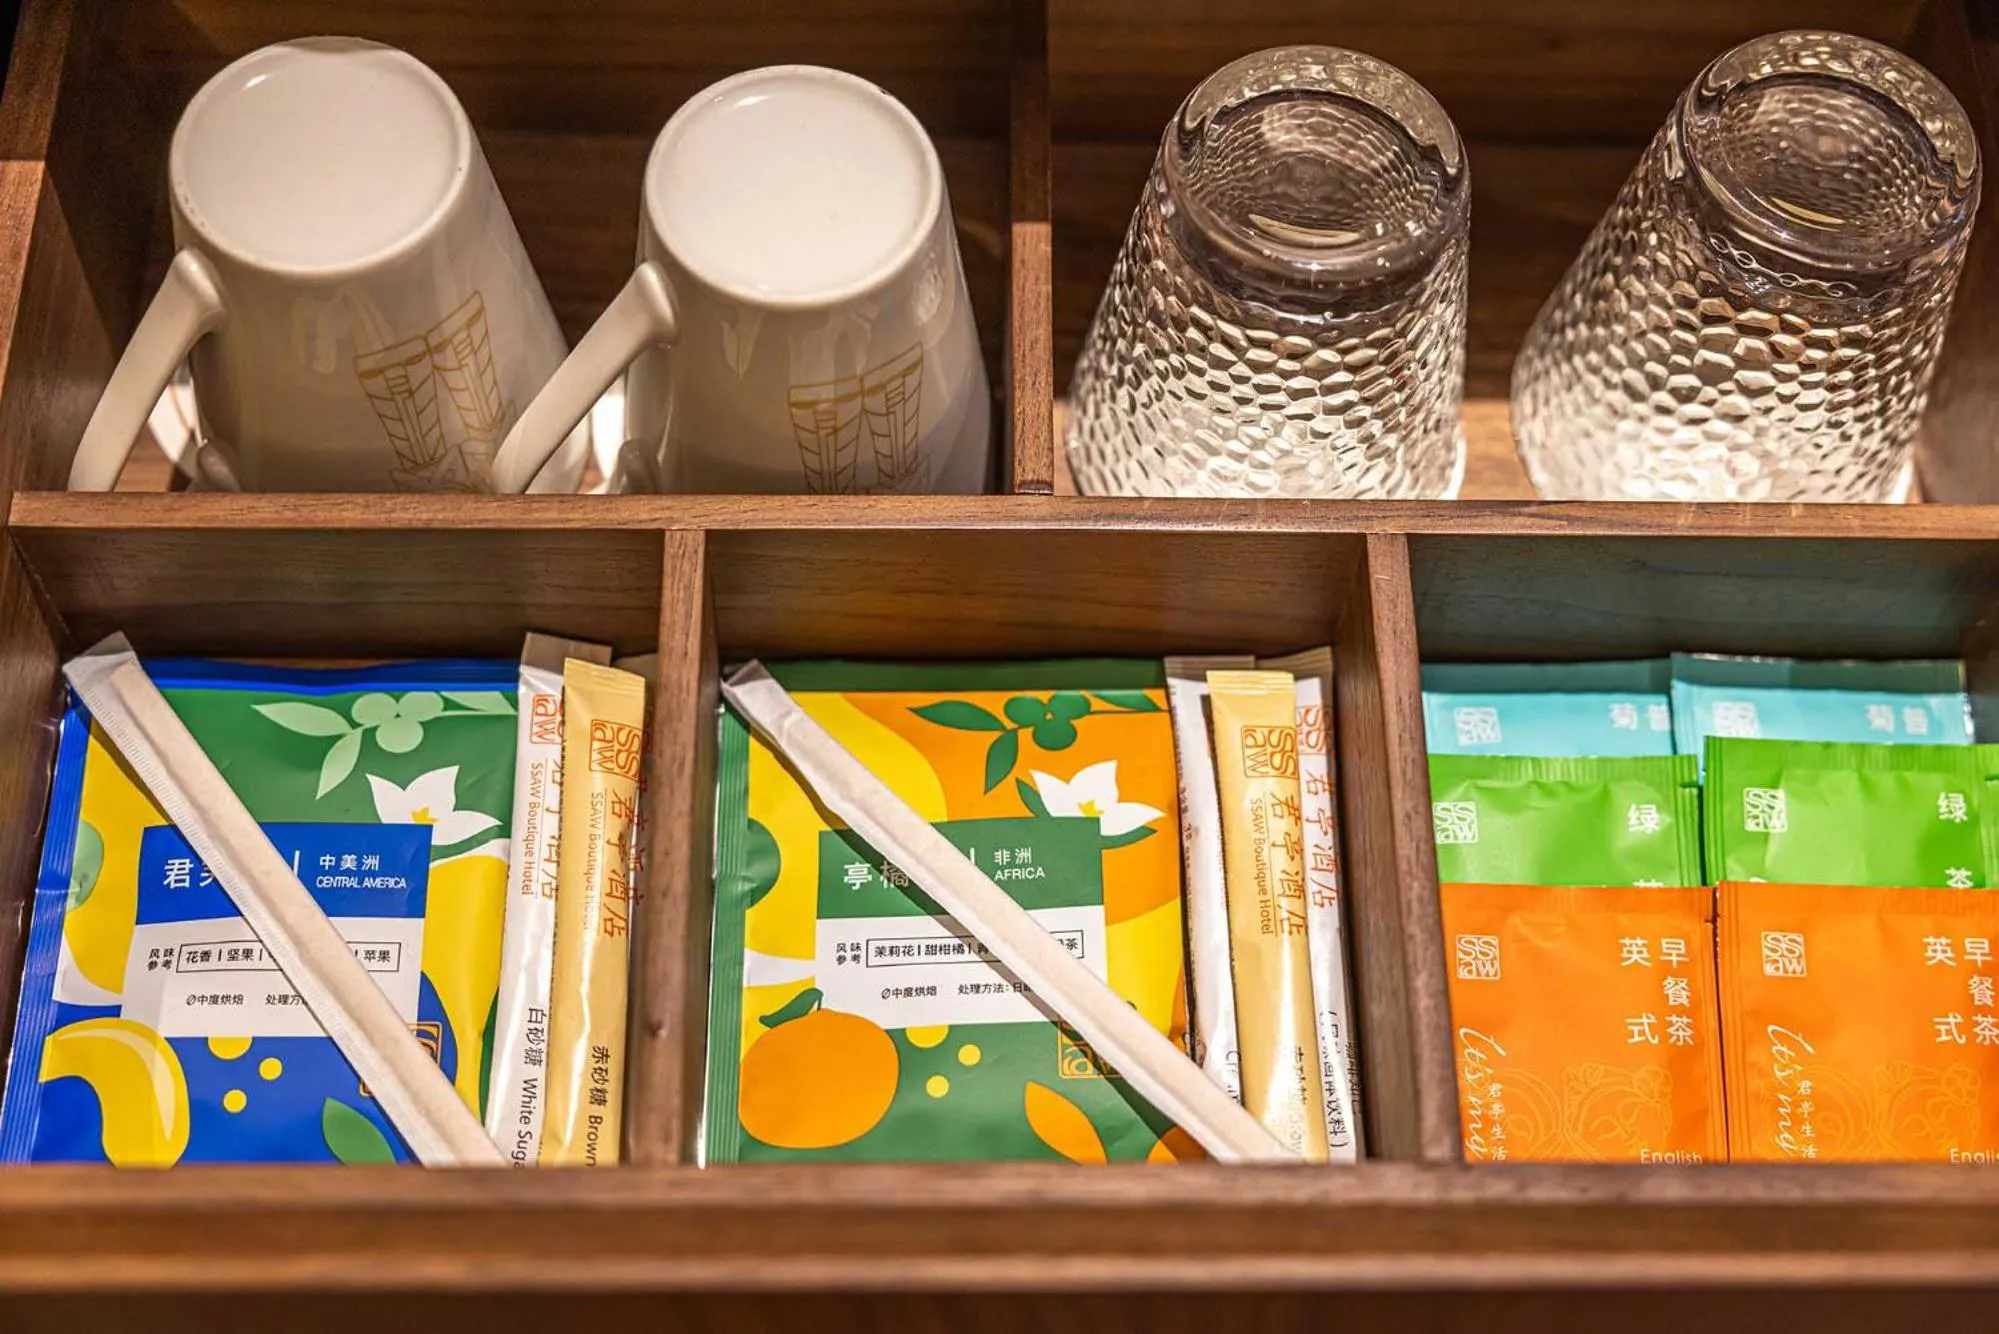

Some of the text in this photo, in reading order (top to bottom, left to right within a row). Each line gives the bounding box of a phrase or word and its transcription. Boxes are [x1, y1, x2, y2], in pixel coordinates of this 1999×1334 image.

[590, 792, 604, 830] SSAW
[521, 762, 544, 896] SSAW Boutique Hotel
[1305, 768, 1341, 910] 君亭酒店
[319, 854, 380, 871] 中美洲
[585, 833, 603, 891] Boutique
[602, 790, 635, 938] 君亭酒店
[994, 847, 1032, 866] 非洲
[1270, 792, 1308, 938] 君亭酒店
[994, 867, 1045, 880] AFRICA
[1250, 797, 1274, 936] SSAW Boutique Hotel
[316, 876, 407, 889] CENTRAL AMERICA
[148, 948, 175, 959] 风味
[185, 949, 212, 963] 花香
[226, 948, 254, 961] 坚果
[363, 949, 391, 963] 苹果
[836, 942, 862, 953] 风味
[874, 944, 915, 958] 茉莉花
[924, 943, 965, 956] 甜柑橘
[147, 960, 174, 971] 参考
[836, 954, 862, 965] 参考
[197, 994, 244, 1006] 中度烘焙
[265, 994, 308, 1006] 处理方
[891, 986, 937, 999] 中度烘焙
[1660, 938, 1695, 1047] 早餐茶
[523, 1007, 547, 1067] 白砂糖
[588, 1045, 612, 1107] 赤砂糖
[519, 1077, 539, 1126] White
[585, 1114, 604, 1168] Brown
[1640, 1148, 1702, 1165] English
